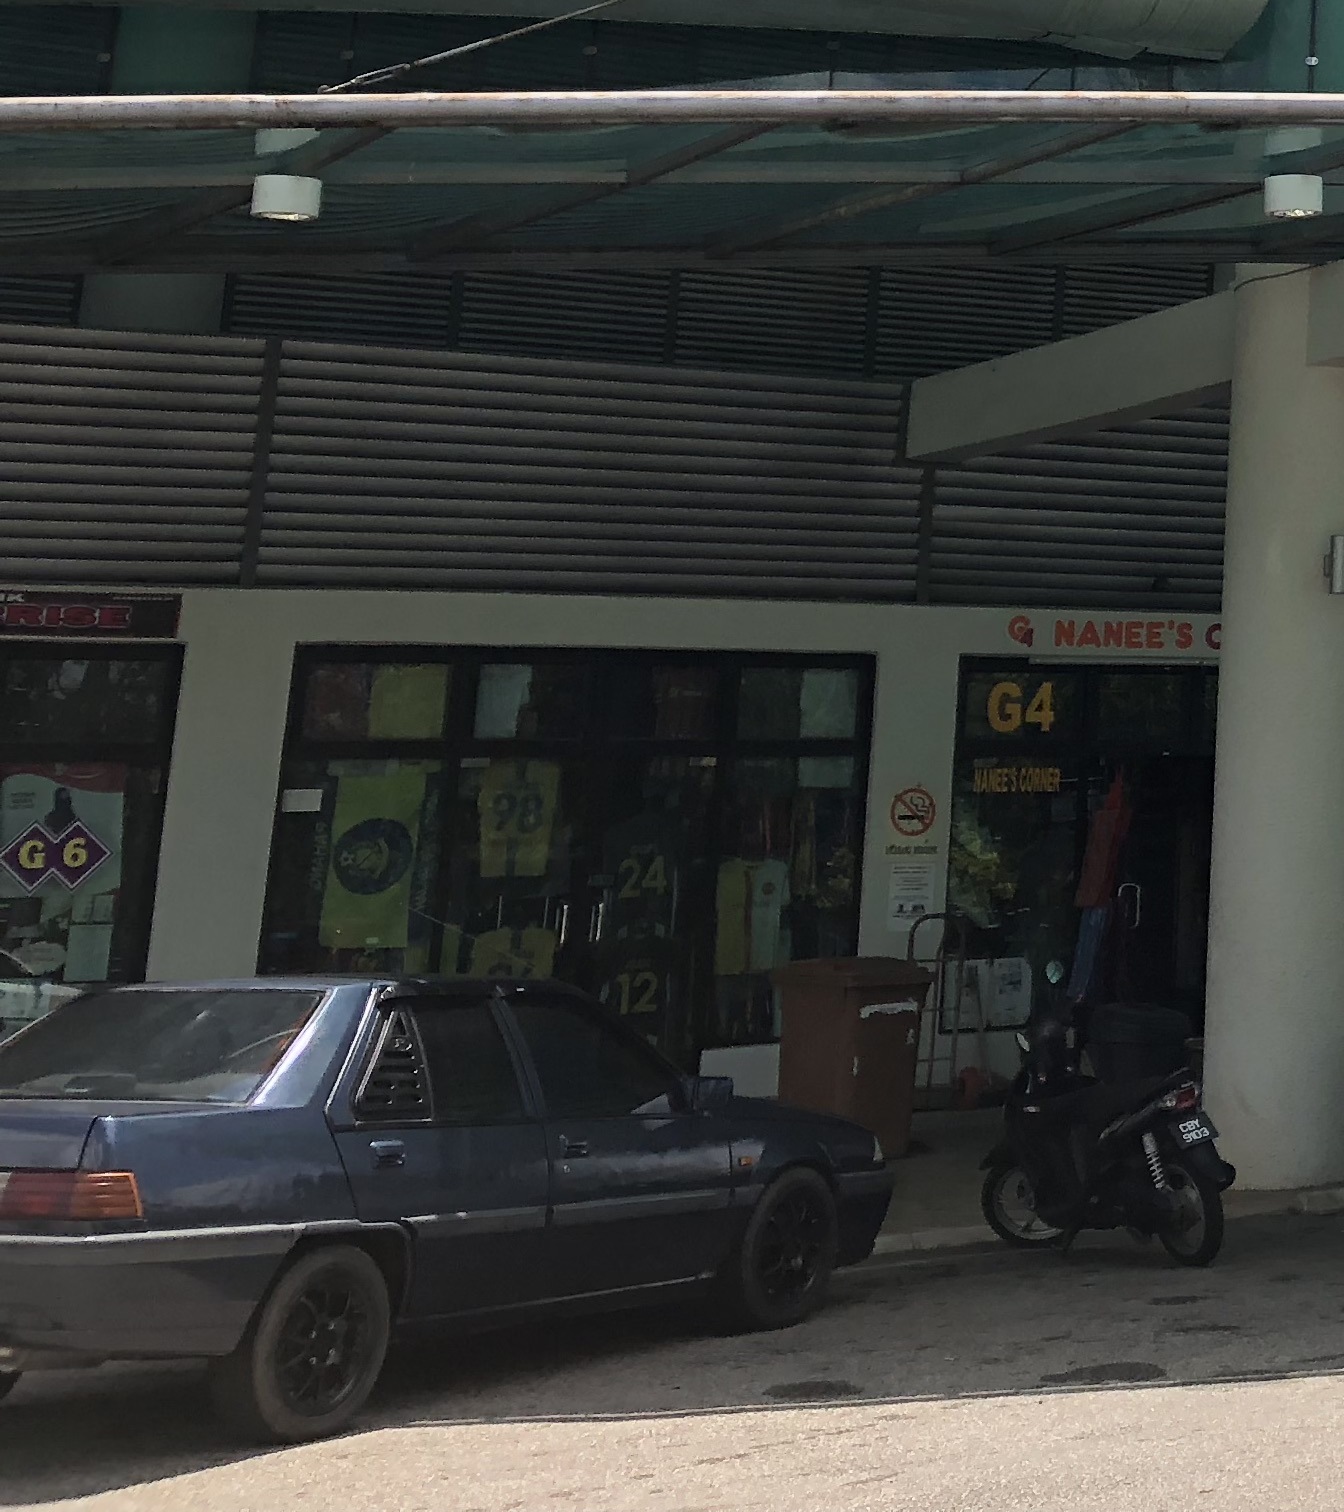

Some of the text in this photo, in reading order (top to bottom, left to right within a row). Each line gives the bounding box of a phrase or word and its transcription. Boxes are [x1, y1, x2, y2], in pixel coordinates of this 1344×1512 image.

[0, 604, 133, 629] RISE
[1054, 619, 1194, 650] NANEE'S
[986, 680, 1056, 734] G4
[491, 792, 543, 834] 98
[18, 836, 89, 870] G 6
[617, 854, 668, 900] 24
[615, 970, 658, 1016] 12
[1178, 1118, 1201, 1133] CBY
[1182, 1126, 1210, 1143] 9103
